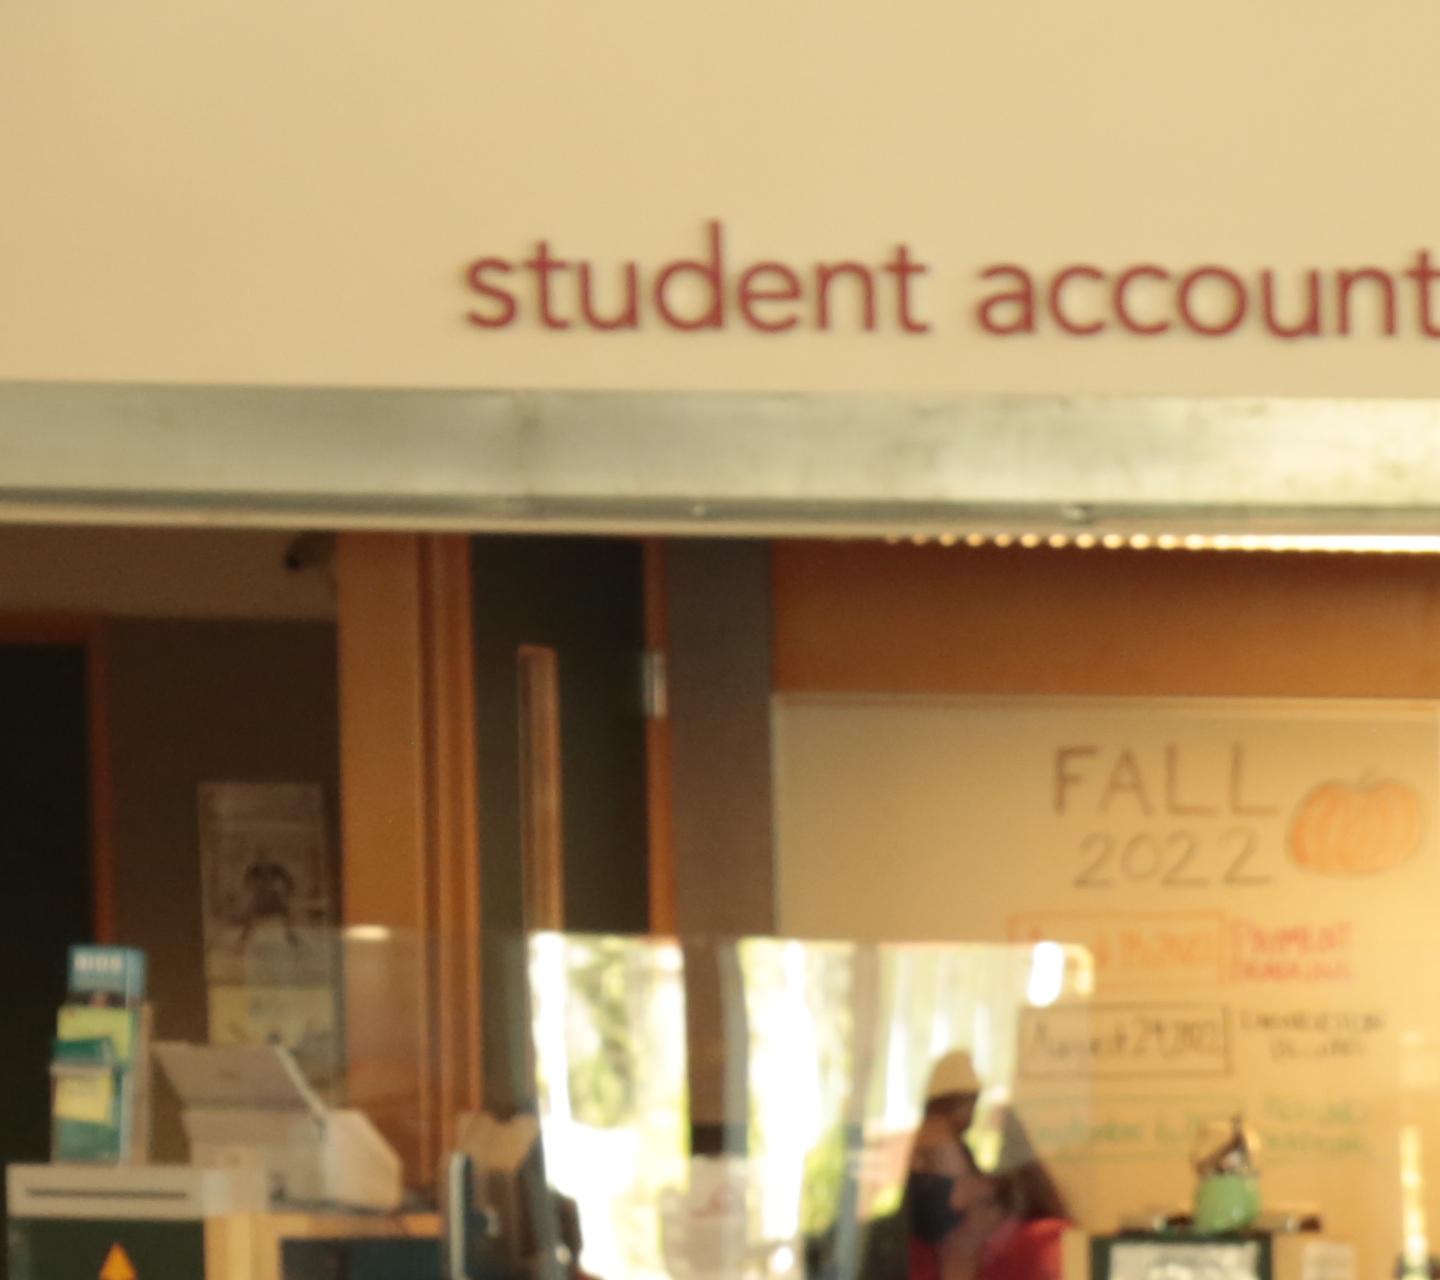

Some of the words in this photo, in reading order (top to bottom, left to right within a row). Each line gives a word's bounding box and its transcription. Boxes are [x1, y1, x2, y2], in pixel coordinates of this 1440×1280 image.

[464, 219, 930, 335] student
[1053, 744, 1281, 819] FALL
[1072, 828, 1272, 891] 2022
